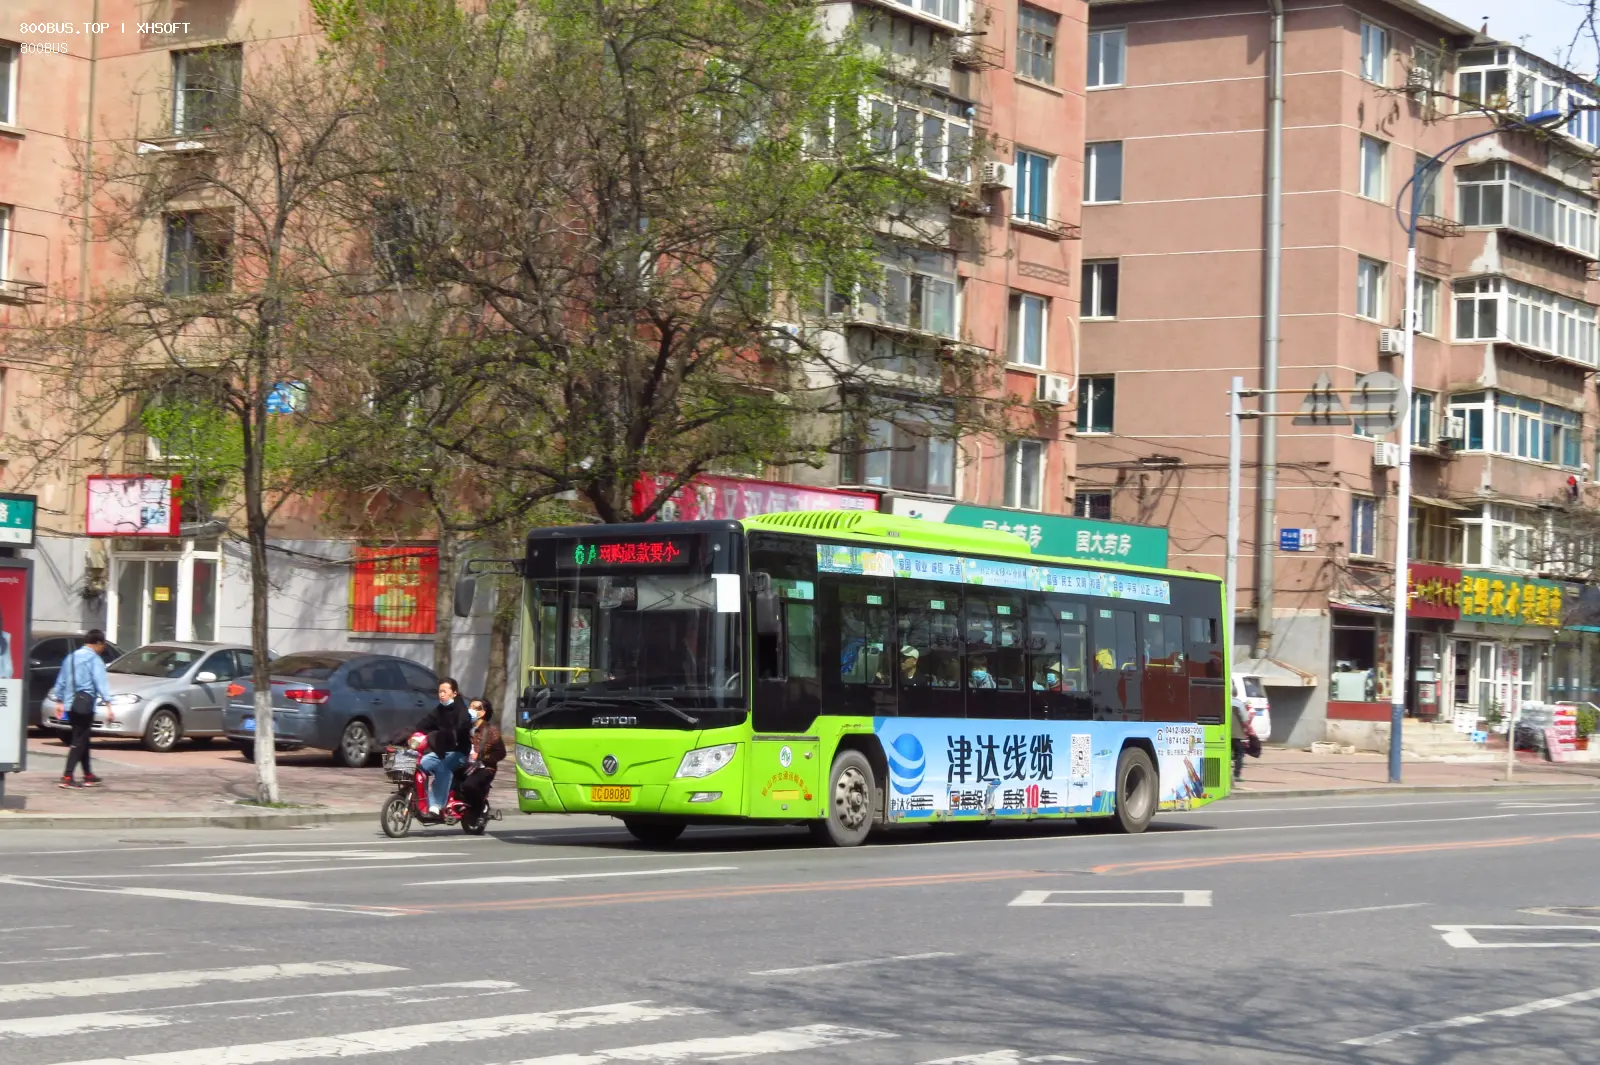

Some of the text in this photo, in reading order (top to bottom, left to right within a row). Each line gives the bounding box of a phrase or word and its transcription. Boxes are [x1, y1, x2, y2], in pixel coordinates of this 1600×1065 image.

[1075, 530, 1132, 556] 国大药房
[1303, 533, 1313, 549] 11
[898, 558, 912, 572] 爱国
[915, 560, 928, 573] 敬业
[931, 562, 944, 574] 诚信
[1061, 575, 1073, 587] 民主
[1076, 576, 1088, 588] 文明
[591, 716, 637, 725] FOTON
[946, 733, 1054, 784] 津达线缆
